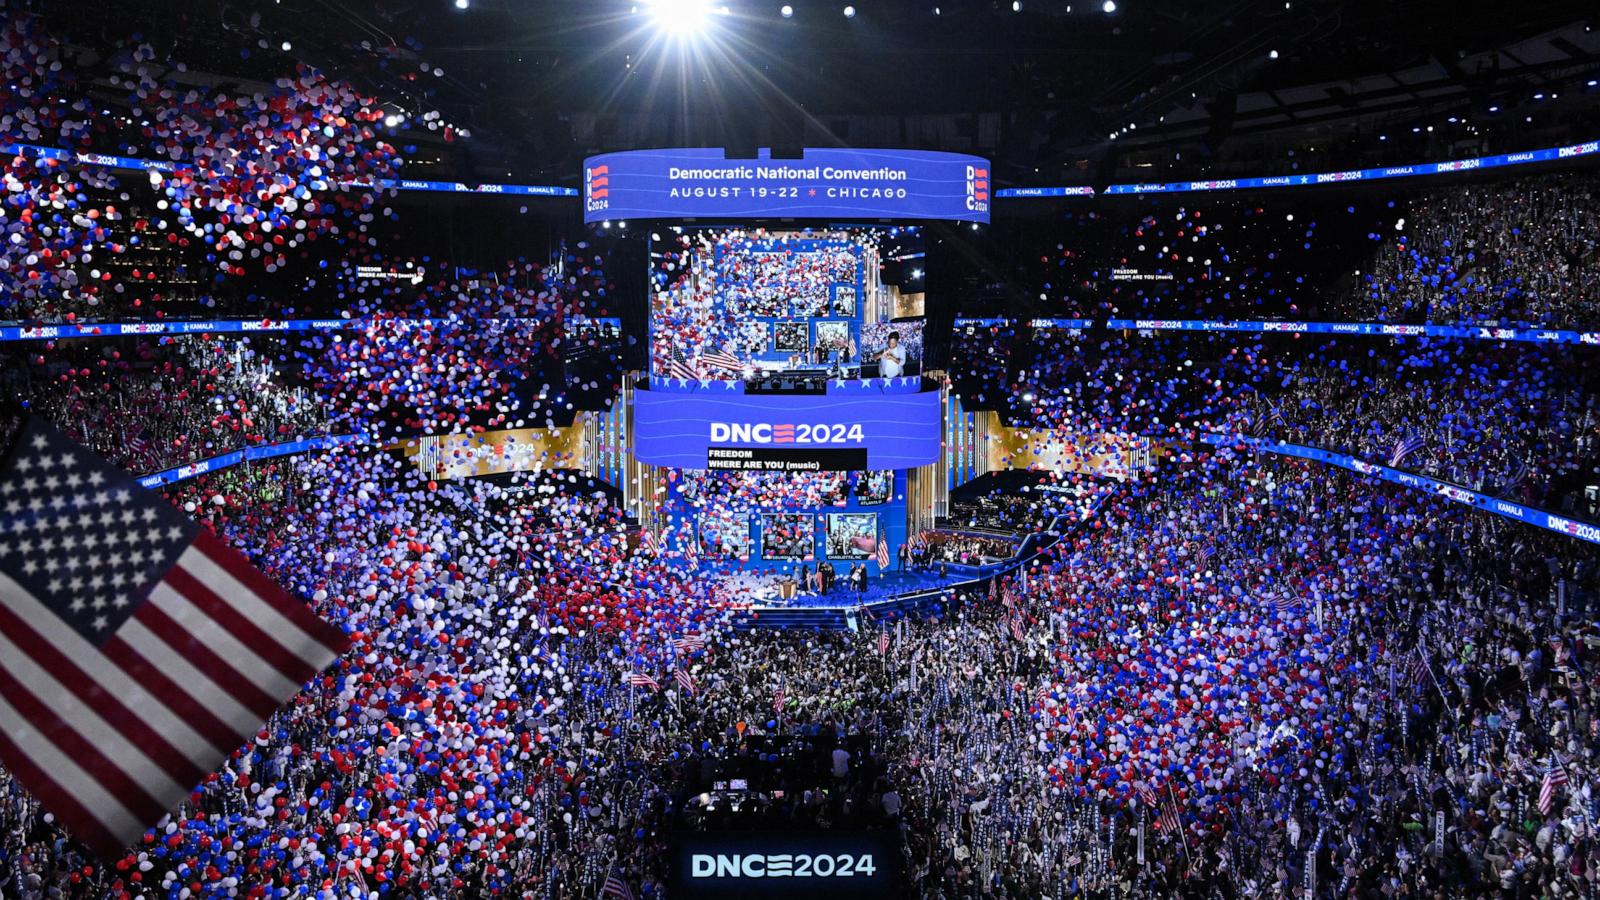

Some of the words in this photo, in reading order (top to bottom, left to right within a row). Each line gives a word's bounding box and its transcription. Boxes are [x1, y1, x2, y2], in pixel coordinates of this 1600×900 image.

[1507, 152, 1534, 162] KAMALA
[1559, 147, 1577, 158] DNC
[1386, 167, 1414, 175] KAMALA
[1437, 162, 1455, 172] DNC
[669, 166, 753, 180] Democratic
[757, 165, 820, 180] National
[823, 166, 907, 181] Convention
[1317, 173, 1336, 183] DNC
[1341, 170, 1362, 180] 2024
[1191, 181, 1210, 191] DNC
[1215, 180, 1237, 189] 2024
[1263, 177, 1290, 185] KAMALA
[669, 187, 741, 199] AUGUST
[750, 186, 799, 198] 19-22
[827, 187, 907, 199] CHICAGO
[1065, 187, 1084, 195] DNC
[121, 324, 139, 334] DNC
[145, 322, 165, 333] 2024
[190, 323, 214, 331] KAMALA
[242, 321, 261, 330] DNC
[1136, 320, 1155, 328] DNC
[1160, 320, 1182, 329] 2024
[711, 422, 772, 443] DNC
[796, 423, 865, 443] 2024
[708, 450, 753, 458] FREEDOM
[708, 460, 742, 468] WHERE
[743, 460, 762, 468] ARE
[764, 461, 784, 469] YOU
[786, 461, 820, 470] (music)
[1497, 502, 1523, 517] KAMALA
[1548, 515, 1569, 531] DNC
[1576, 525, 1600, 540] 2024
[692, 853, 766, 878] DNC
[794, 854, 877, 877] 2024
